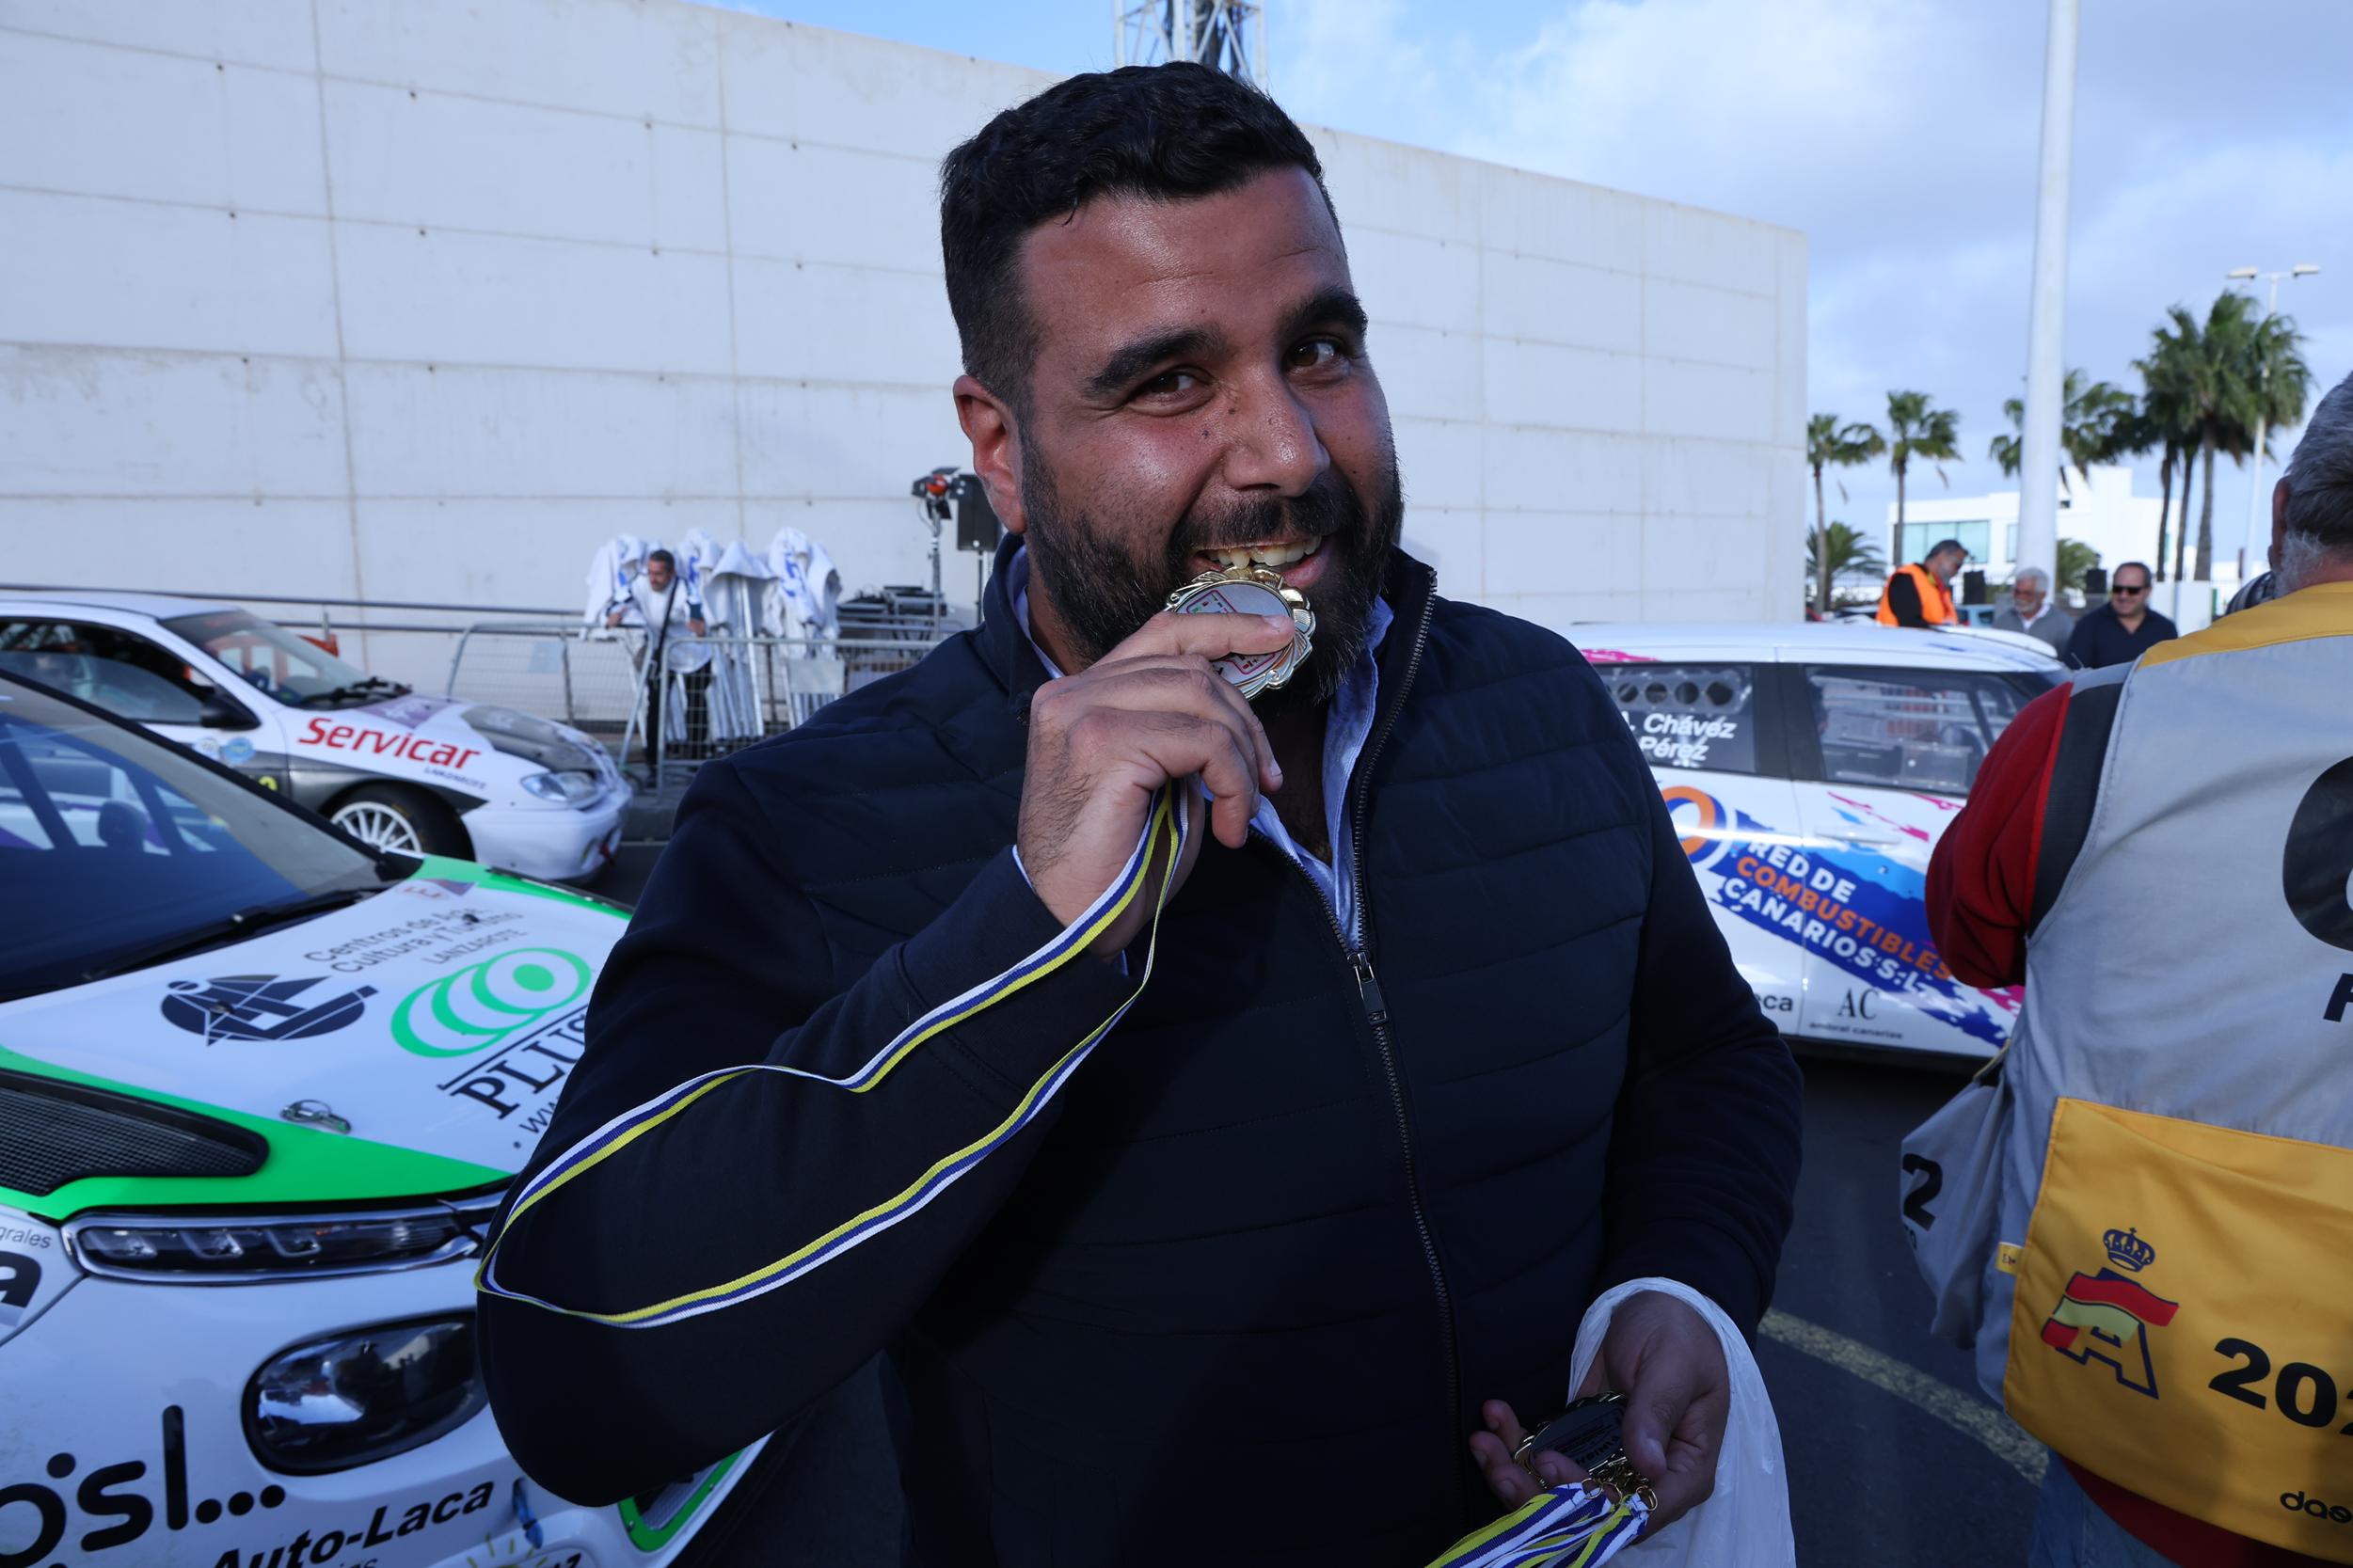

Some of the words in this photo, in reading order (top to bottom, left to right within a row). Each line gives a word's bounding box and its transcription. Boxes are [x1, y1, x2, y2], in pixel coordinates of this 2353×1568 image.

[298, 717, 482, 768] Servicar
[1747, 837, 1810, 879] RED
[1810, 866, 1857, 904] DE
[304, 926, 411, 962] Centros
[1724, 878, 1879, 969] CANARIOS
[1737, 856, 1952, 981] COMBUSTIBLES
[331, 939, 432, 974] Cultura
[1836, 988, 1880, 1021] AC
[2208, 1338, 2353, 1436] 20
[212, 1481, 495, 1568] Auto-Laca
